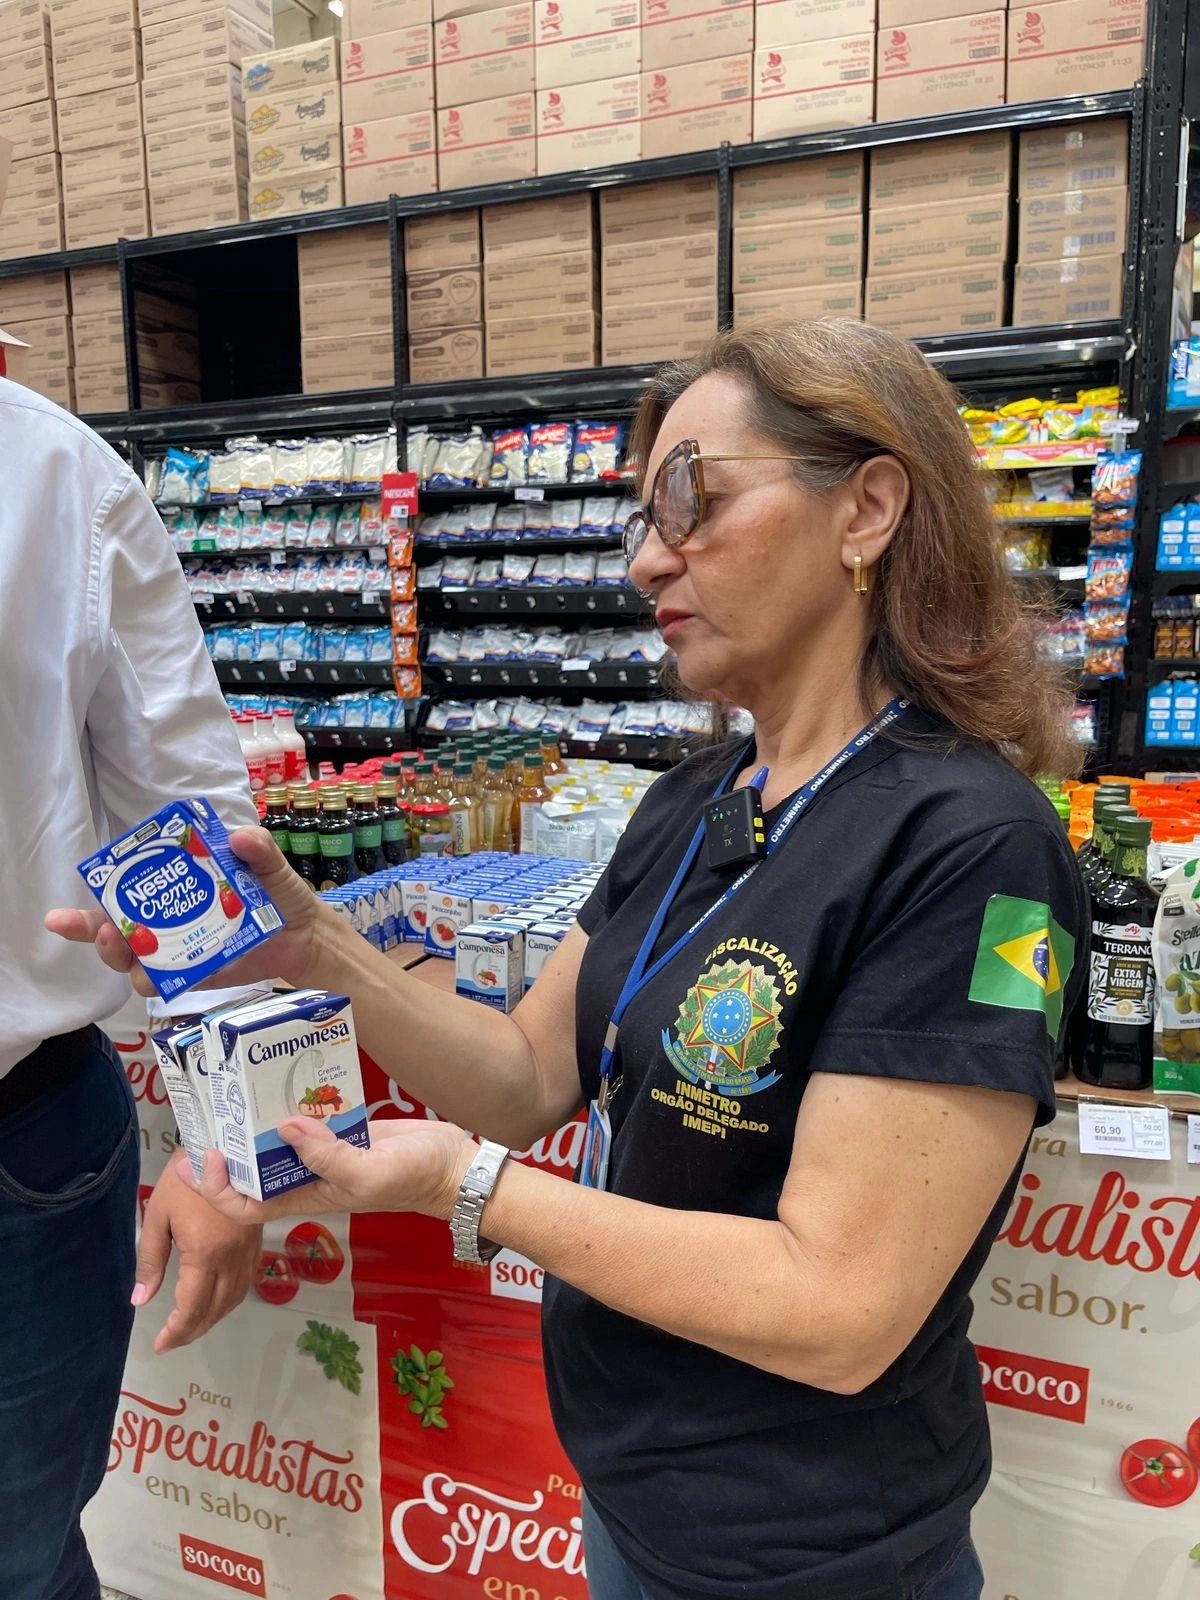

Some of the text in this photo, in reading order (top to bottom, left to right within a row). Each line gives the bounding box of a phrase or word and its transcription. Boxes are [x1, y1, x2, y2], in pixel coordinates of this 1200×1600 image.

[810, 754, 850, 792] INMETRO
[771, 801, 804, 843] INMETRO
[724, 837, 733, 847] TX
[125, 855, 189, 907] Nestlé
[140, 877, 198, 919] Creme
[182, 926, 207, 946] LEVE
[458, 940, 505, 954] Camponesa
[1109, 977, 1144, 988] VIRGEM
[1114, 968, 1142, 979] EXTRA
[248, 1022, 350, 1065] Camponesa
[317, 1064, 341, 1077] Creme
[318, 1070, 348, 1084] de Leite
[650, 1088, 769, 1133] ORGÃO DELEGADO
[676, 1079, 741, 1116] INMETRO
[683, 1113, 726, 1140] IMEPI
[1094, 1125, 1121, 1136] 60,90
[264, 1178, 282, 1193] CREME
[283, 1176, 290, 1186] DE
[291, 1169, 306, 1183] LEITE
[496, 1261, 544, 1290] SOC
[990, 1273, 1148, 1335] sabor.
[188, 1382, 232, 1410] Para
[145, 1475, 292, 1538] em sabor.
